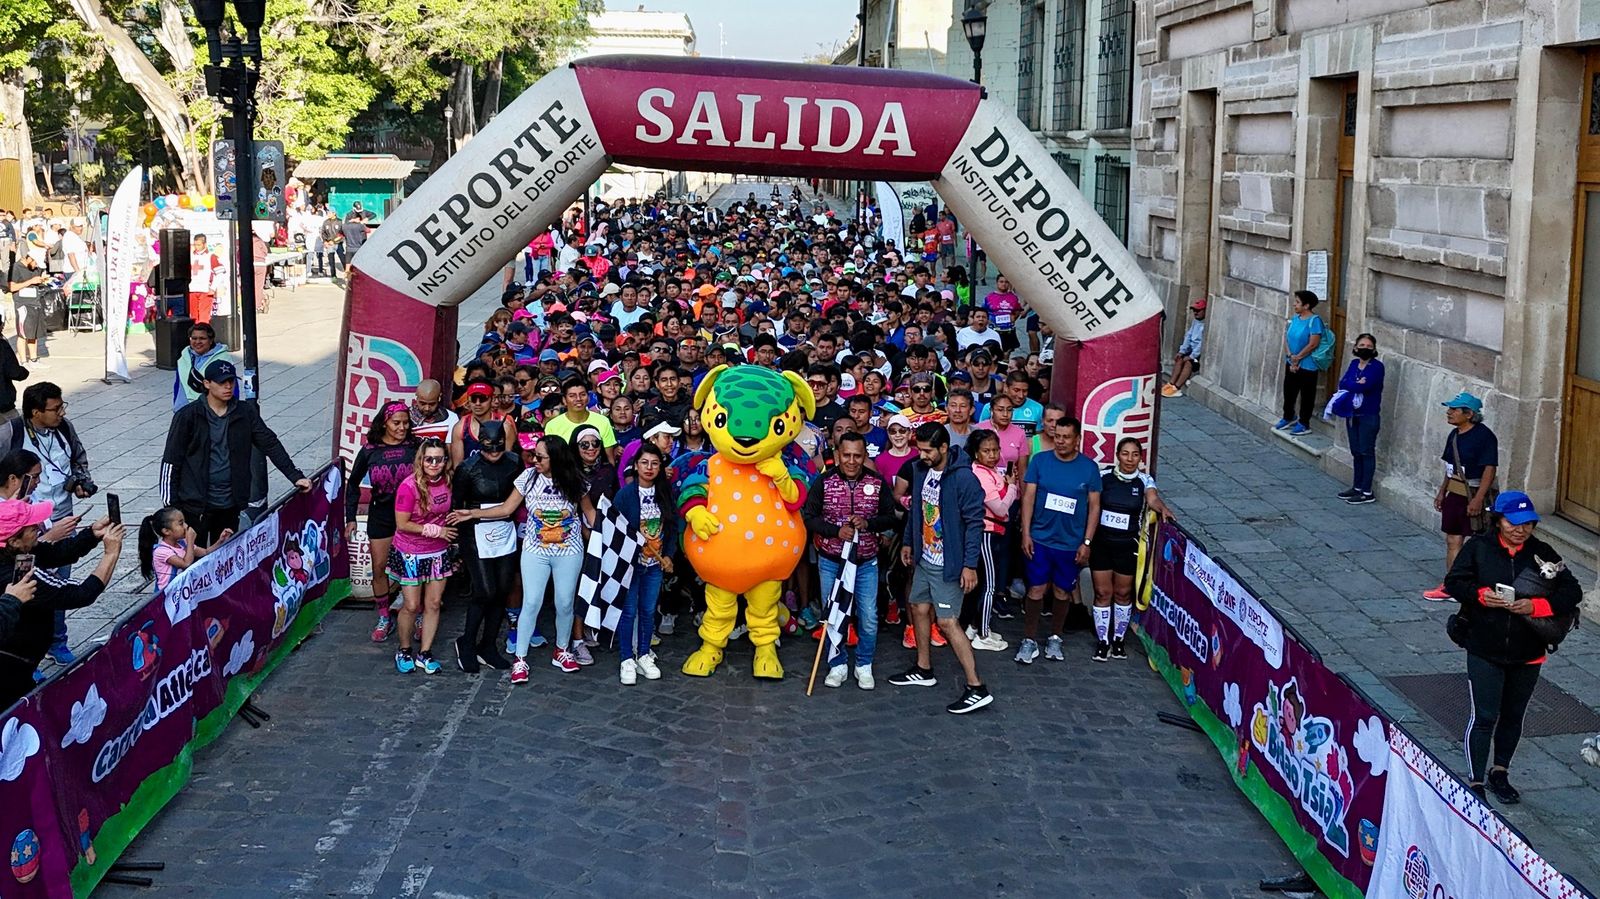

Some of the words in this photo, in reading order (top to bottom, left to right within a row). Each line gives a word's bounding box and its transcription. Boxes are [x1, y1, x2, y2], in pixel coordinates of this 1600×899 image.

[386, 99, 582, 282] DEPORTE
[635, 87, 917, 157] SALIDA
[417, 227, 495, 297] INSTITUTO
[492, 200, 529, 231] DEL
[522, 134, 597, 202] DEPORTE
[952, 154, 1018, 231] INSTITUTO
[1013, 230, 1043, 265] DEL
[1038, 261, 1102, 332] DEPORTE
[970, 126, 1135, 319] DEPORTE
[1105, 514, 1128, 524] 1784
